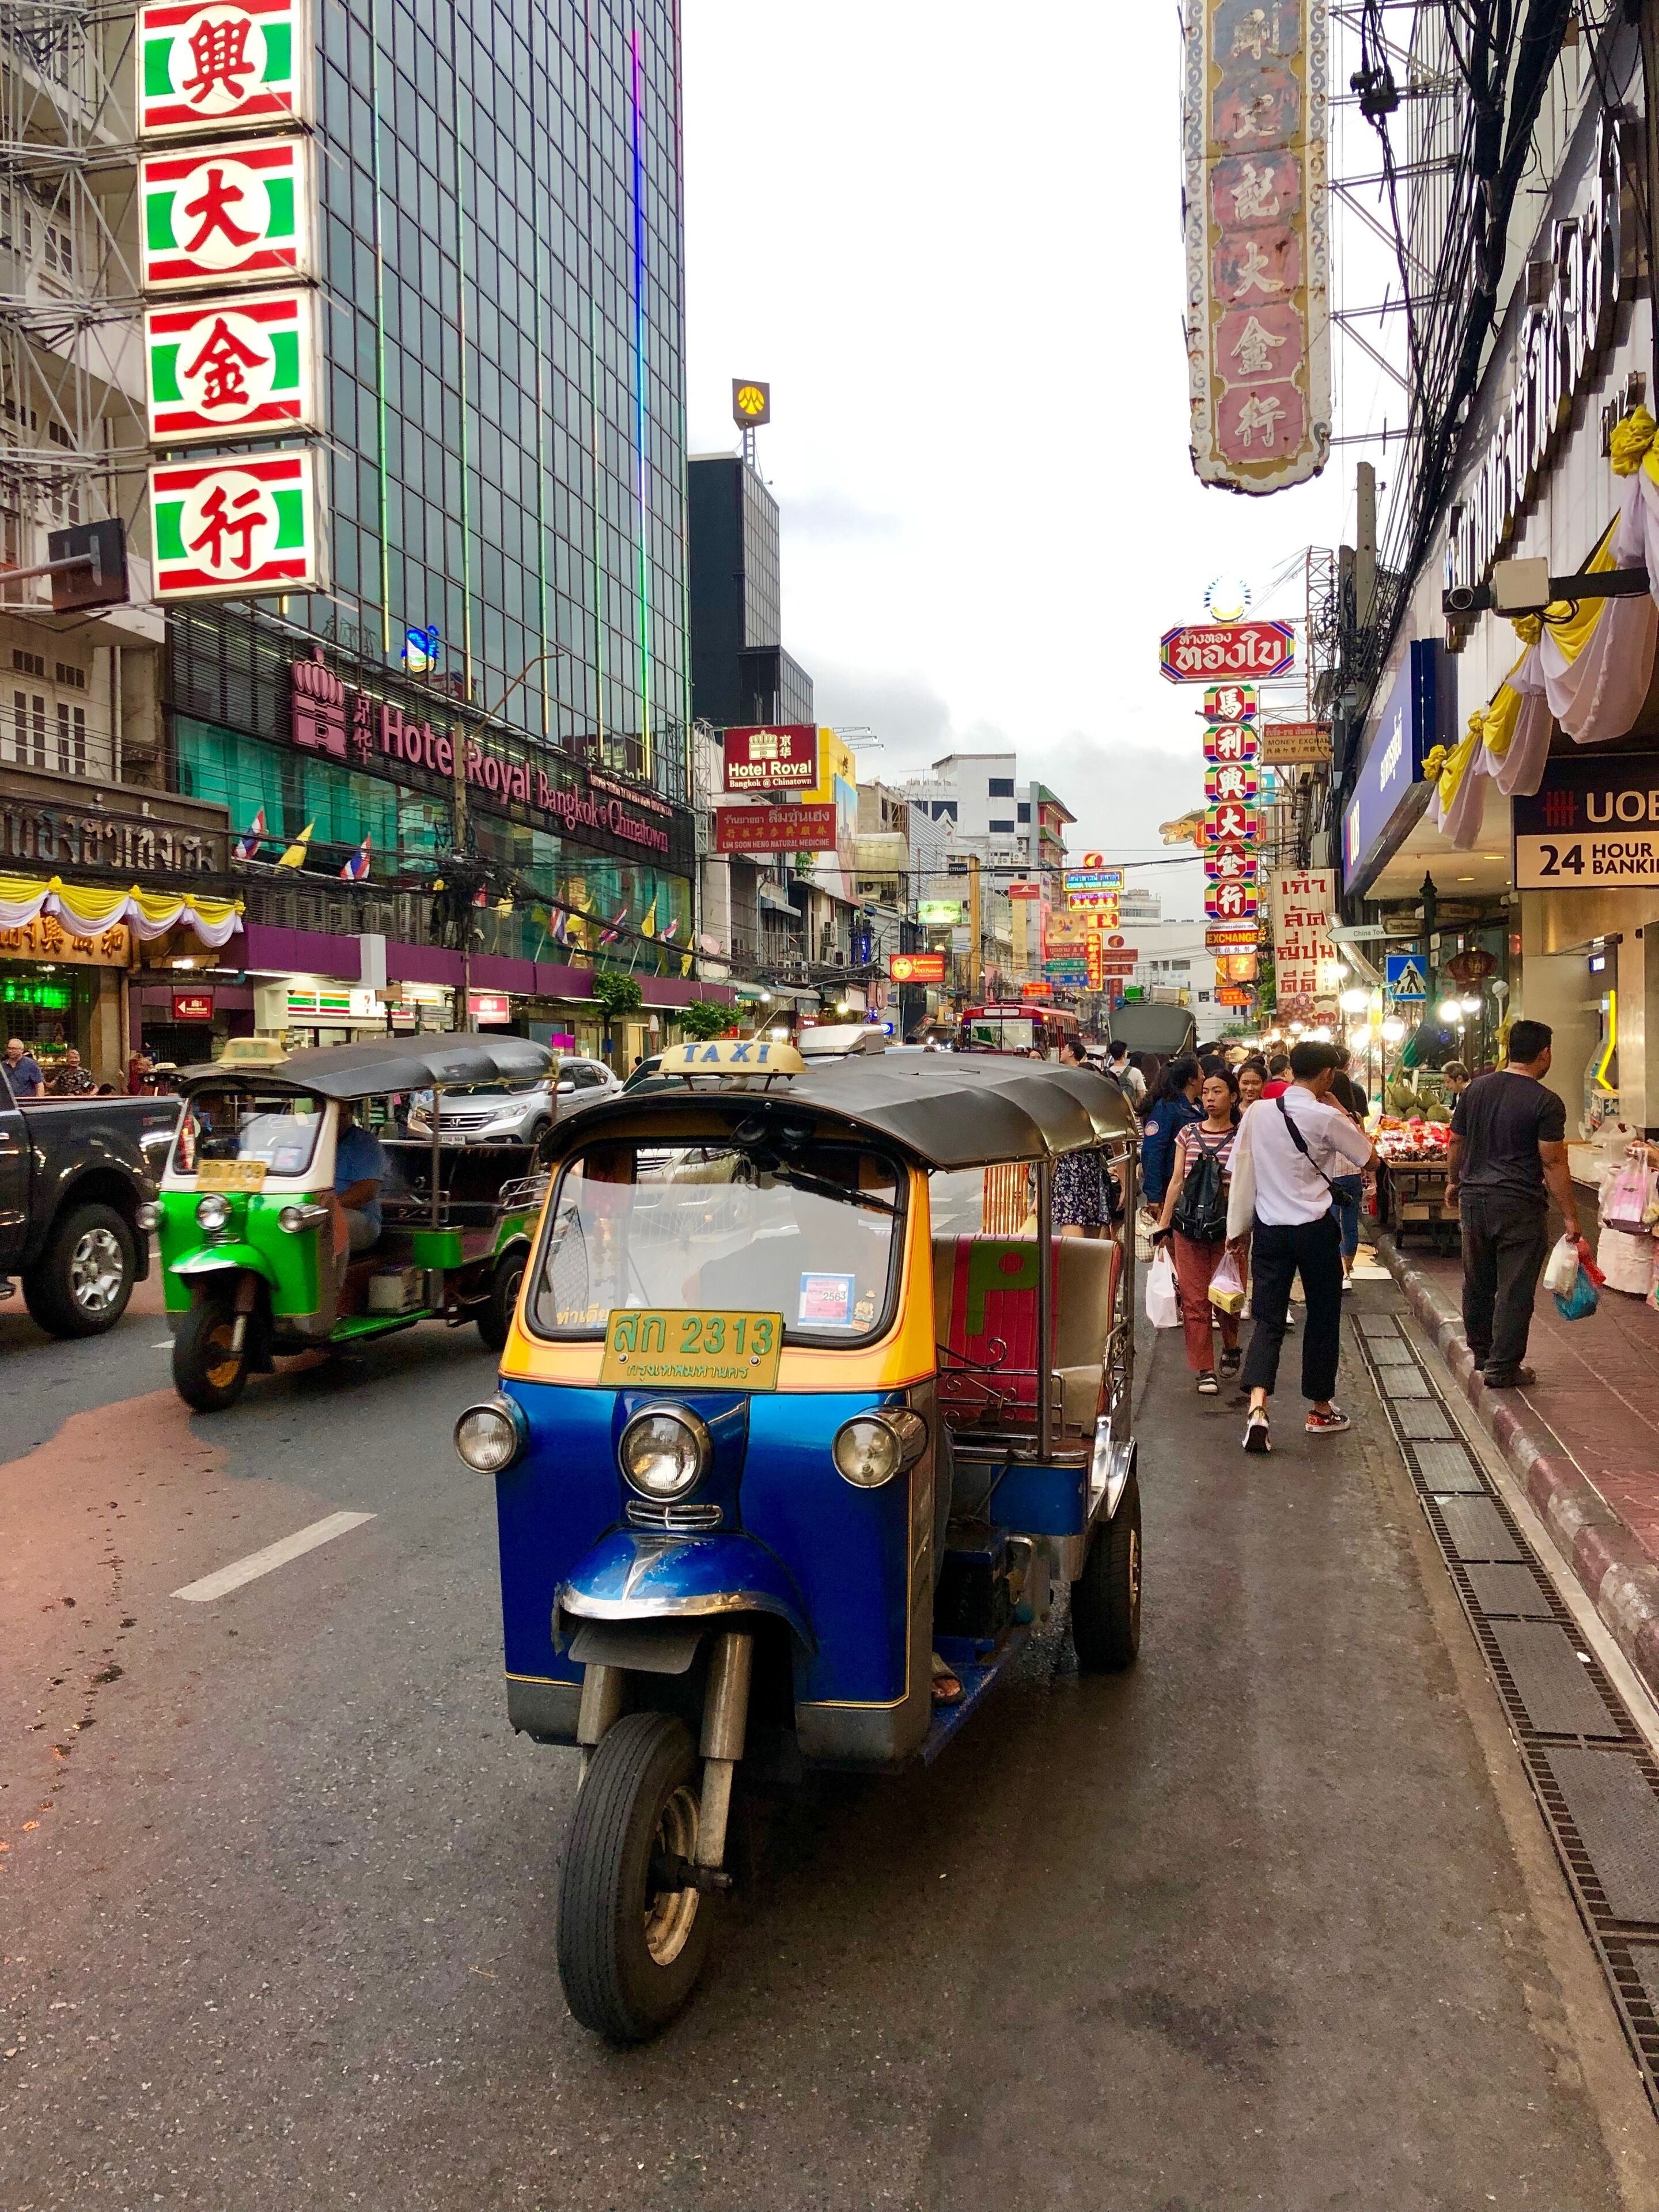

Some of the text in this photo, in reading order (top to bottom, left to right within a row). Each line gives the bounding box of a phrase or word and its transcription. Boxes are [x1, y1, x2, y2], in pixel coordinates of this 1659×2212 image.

[728, 759, 812, 777] Hotel Royal
[381, 704, 456, 776] Hotel
[465, 739, 531, 805] Royal
[536, 770, 602, 831] Bangkok
[608, 799, 669, 853] Chinatown
[729, 778, 812, 789] Bangkok @ Chinatown
[1350, 800, 1360, 866] UOB
[722, 838, 830, 849] LIM SOON HENG NATURAL MEDICINE
[1592, 843, 1653, 858] HOUR
[1539, 844, 1585, 876] 24
[1206, 932, 1257, 944] EXCHANGE
[1353, 929, 1372, 937] China
[683, 1043, 770, 1063] TAXI
[823, 1291, 846, 1301] 2563
[614, 1313, 774, 1354] สก 2313
[626, 1363, 749, 1381] กรุงเทพมหานคร
